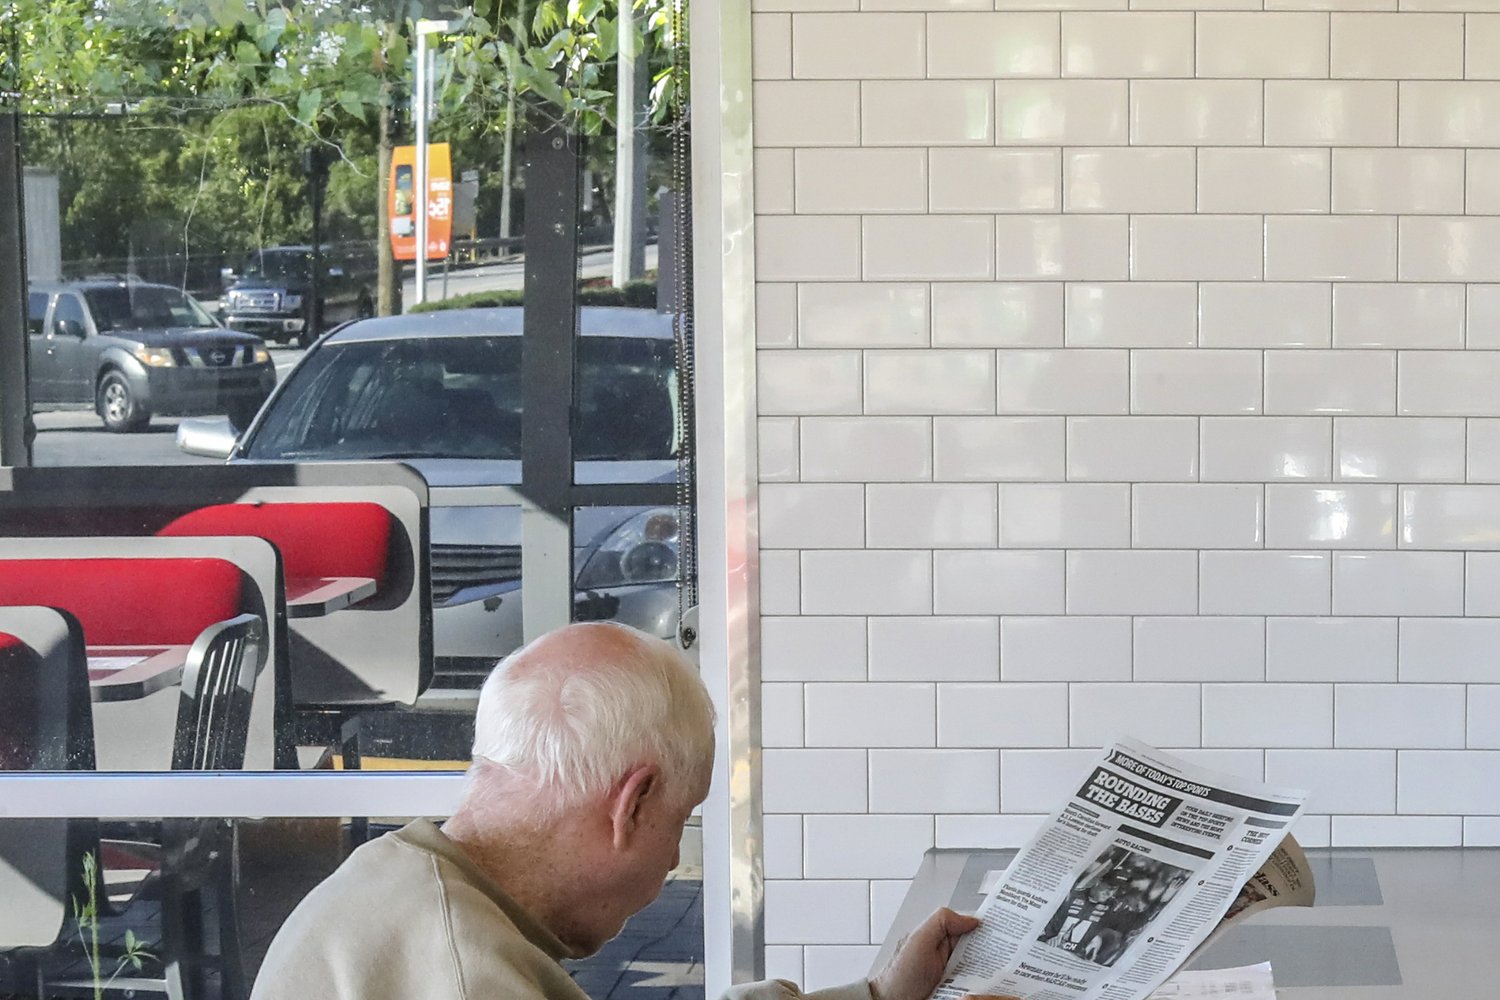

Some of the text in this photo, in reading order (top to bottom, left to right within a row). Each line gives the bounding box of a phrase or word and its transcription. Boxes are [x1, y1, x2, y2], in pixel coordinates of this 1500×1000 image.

[1094, 770, 1171, 810] ROUNDING
[1115, 754, 1137, 772] MORE
[1135, 763, 1148, 777] OF
[1146, 768, 1176, 789] TODAY'S
[1172, 779, 1186, 792] TOP
[1184, 782, 1211, 798] SPORTS
[1085, 784, 1165, 825] THE BASES
[1115, 837, 1152, 854] AUTO RACING
